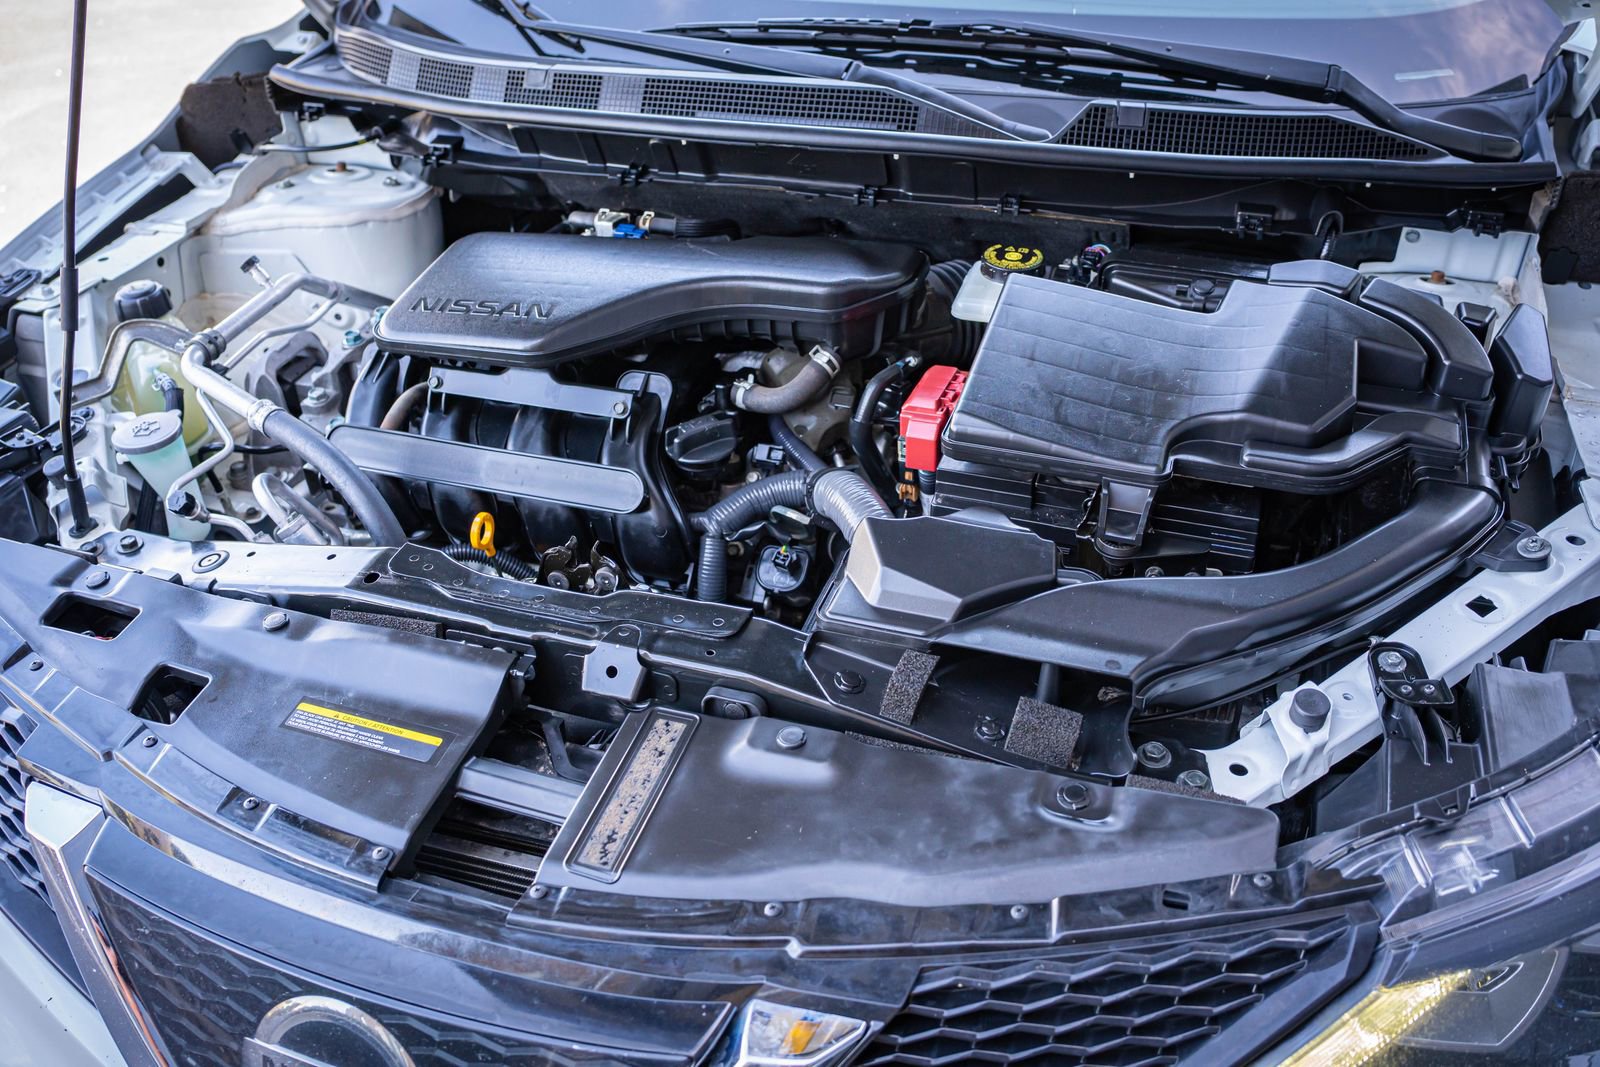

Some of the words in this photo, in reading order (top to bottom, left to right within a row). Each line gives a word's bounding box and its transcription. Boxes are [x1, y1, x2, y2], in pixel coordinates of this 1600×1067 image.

[408, 296, 557, 320] NISSAN
[341, 715, 368, 725] CAUTION
[371, 722, 404, 734] ATTENTION
